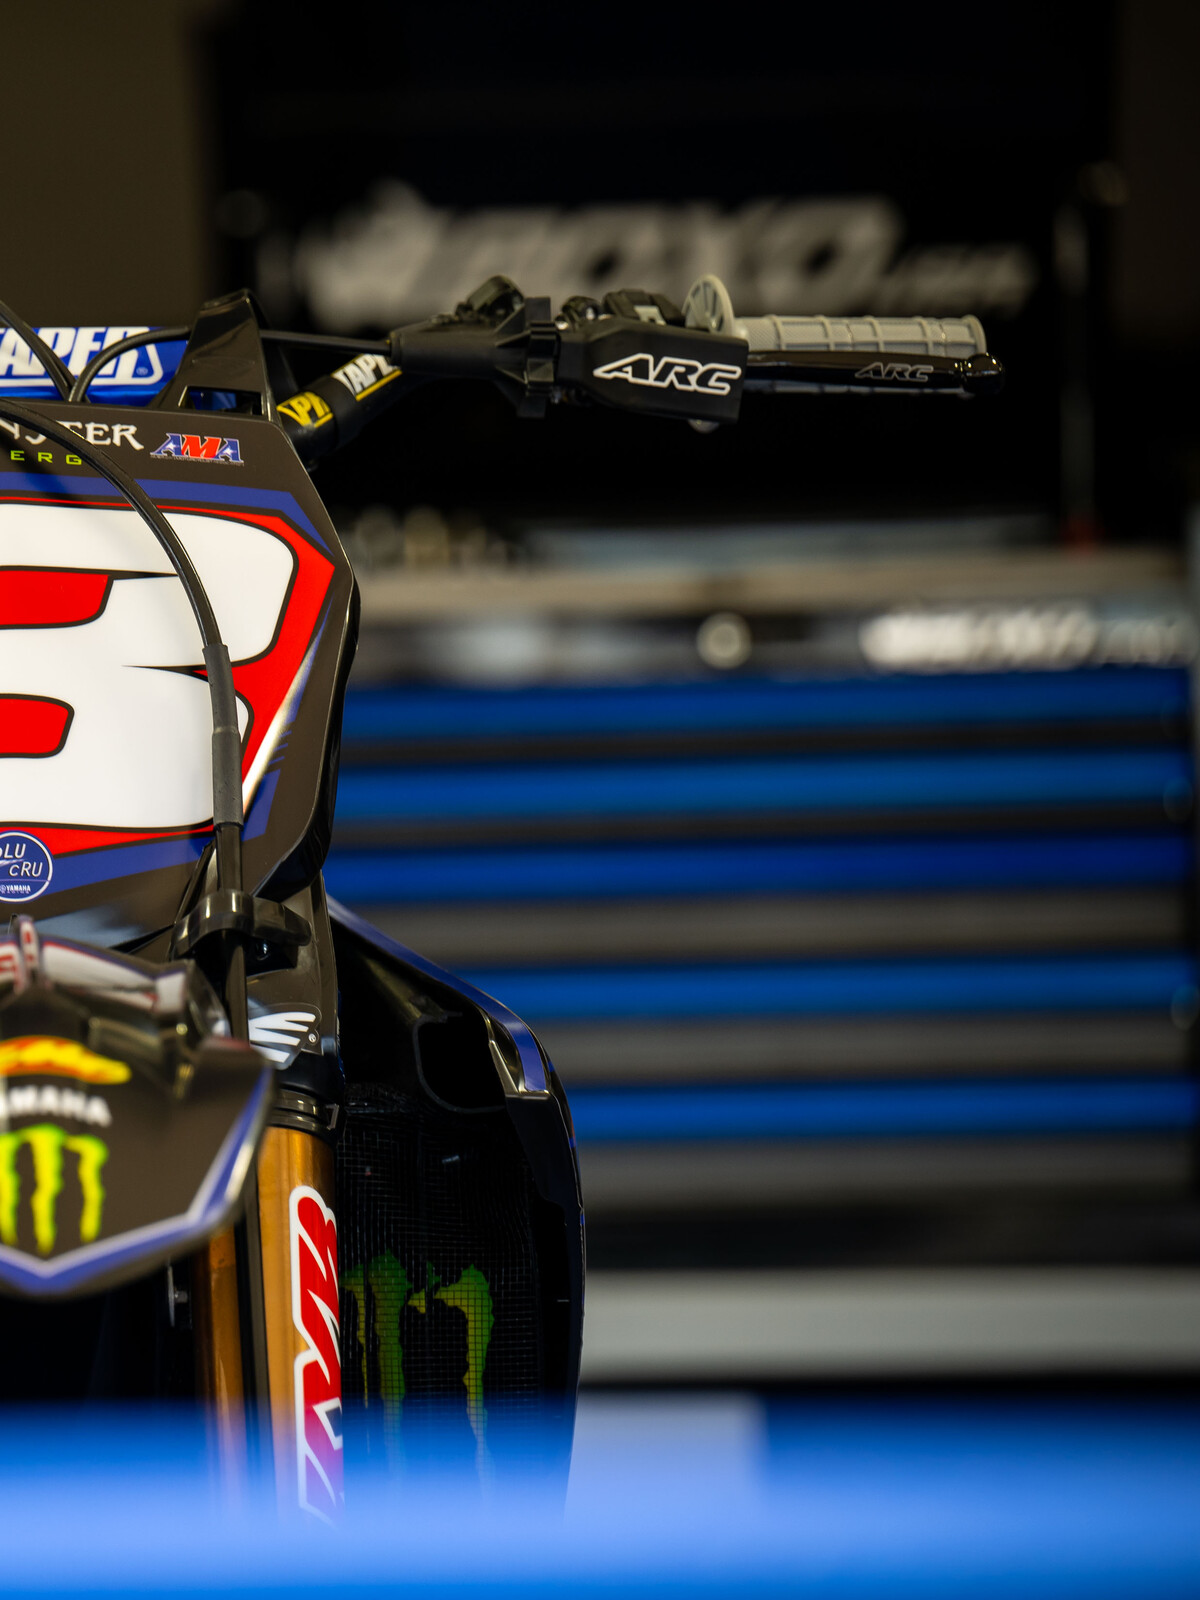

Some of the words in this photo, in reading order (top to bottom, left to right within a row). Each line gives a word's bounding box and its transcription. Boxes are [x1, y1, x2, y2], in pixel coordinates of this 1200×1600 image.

[593, 352, 742, 396] ARC
[854, 361, 934, 383] ARC
[150, 432, 244, 465] AMA
